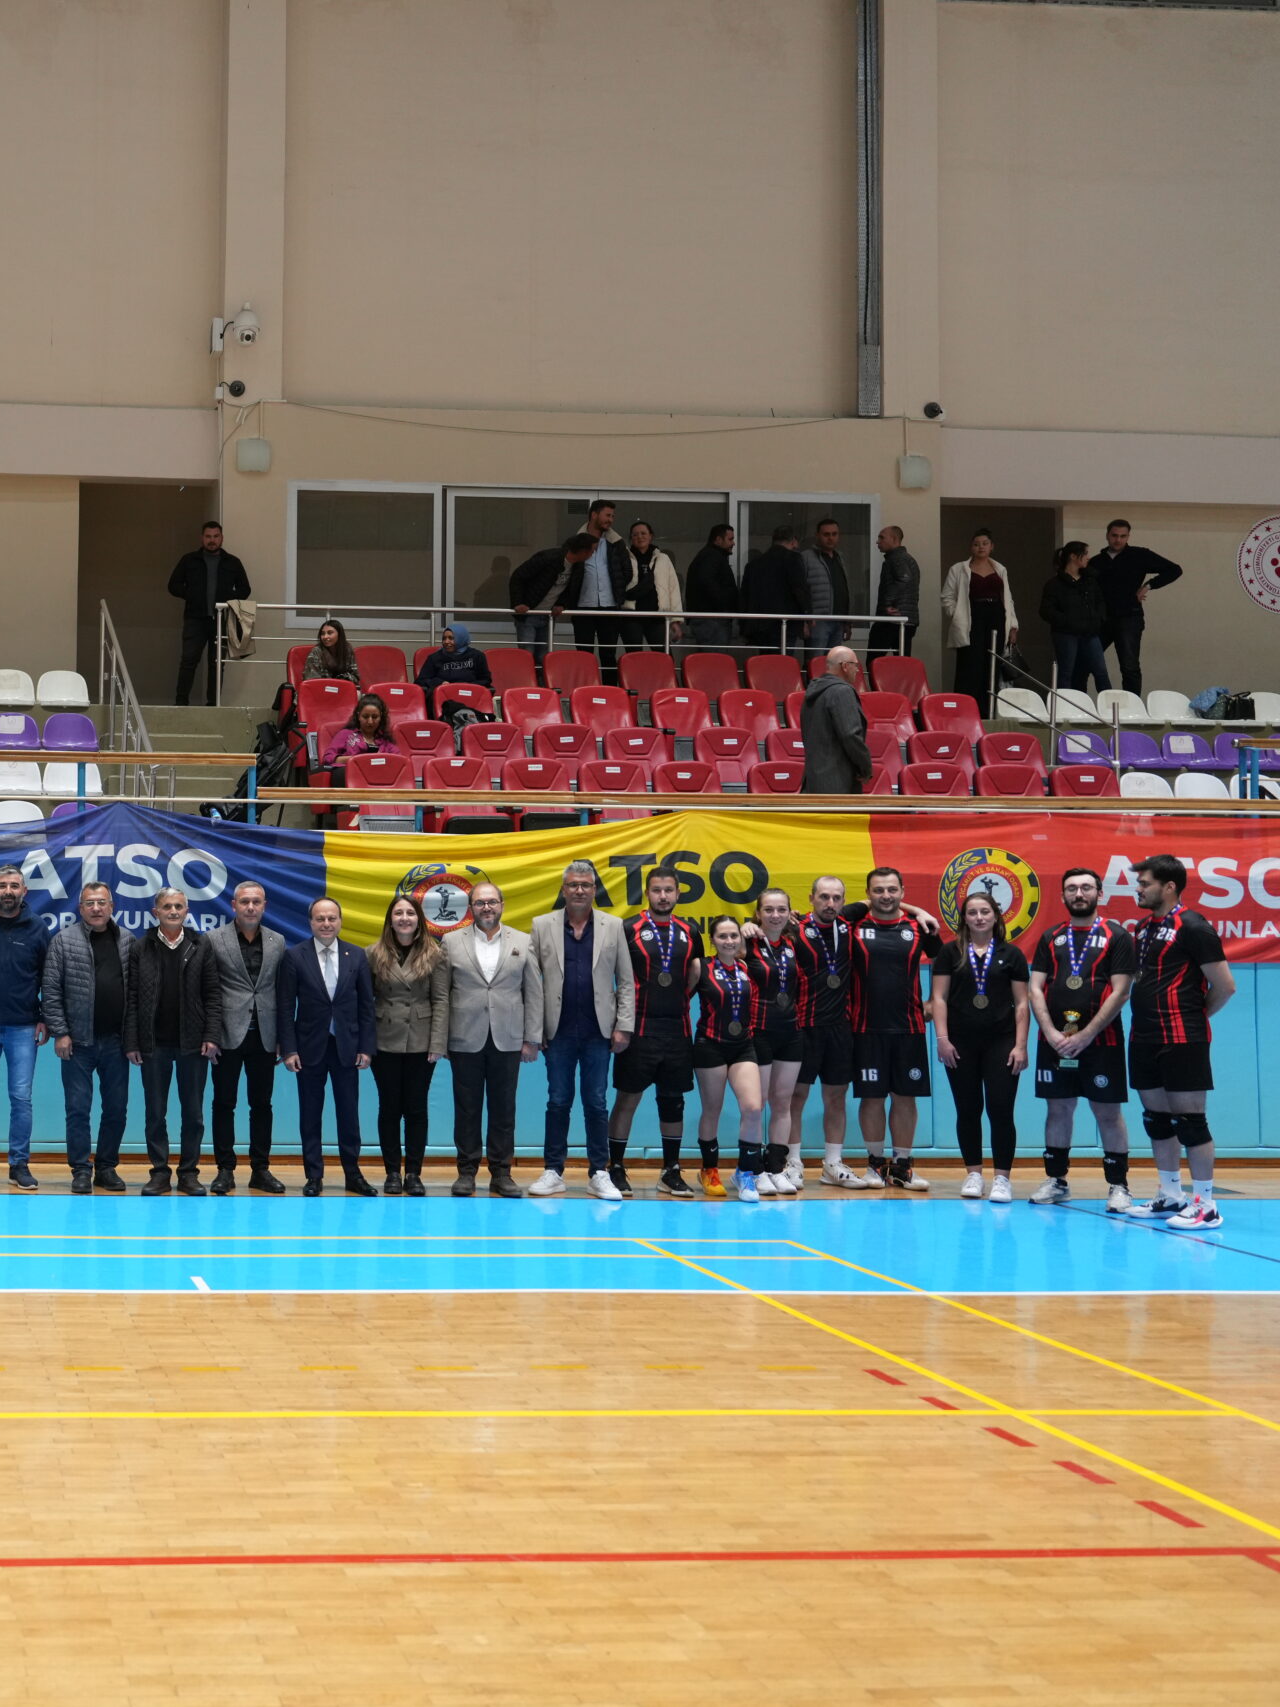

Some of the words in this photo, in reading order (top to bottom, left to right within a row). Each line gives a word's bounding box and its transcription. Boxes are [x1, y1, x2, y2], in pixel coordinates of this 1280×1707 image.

[20, 843, 228, 901] ATSO
[552, 850, 769, 909] ATSO
[1096, 855, 1280, 909] ASO
[858, 927, 876, 940] 16
[860, 1068, 878, 1081] 16
[1037, 1069, 1053, 1082] 10
